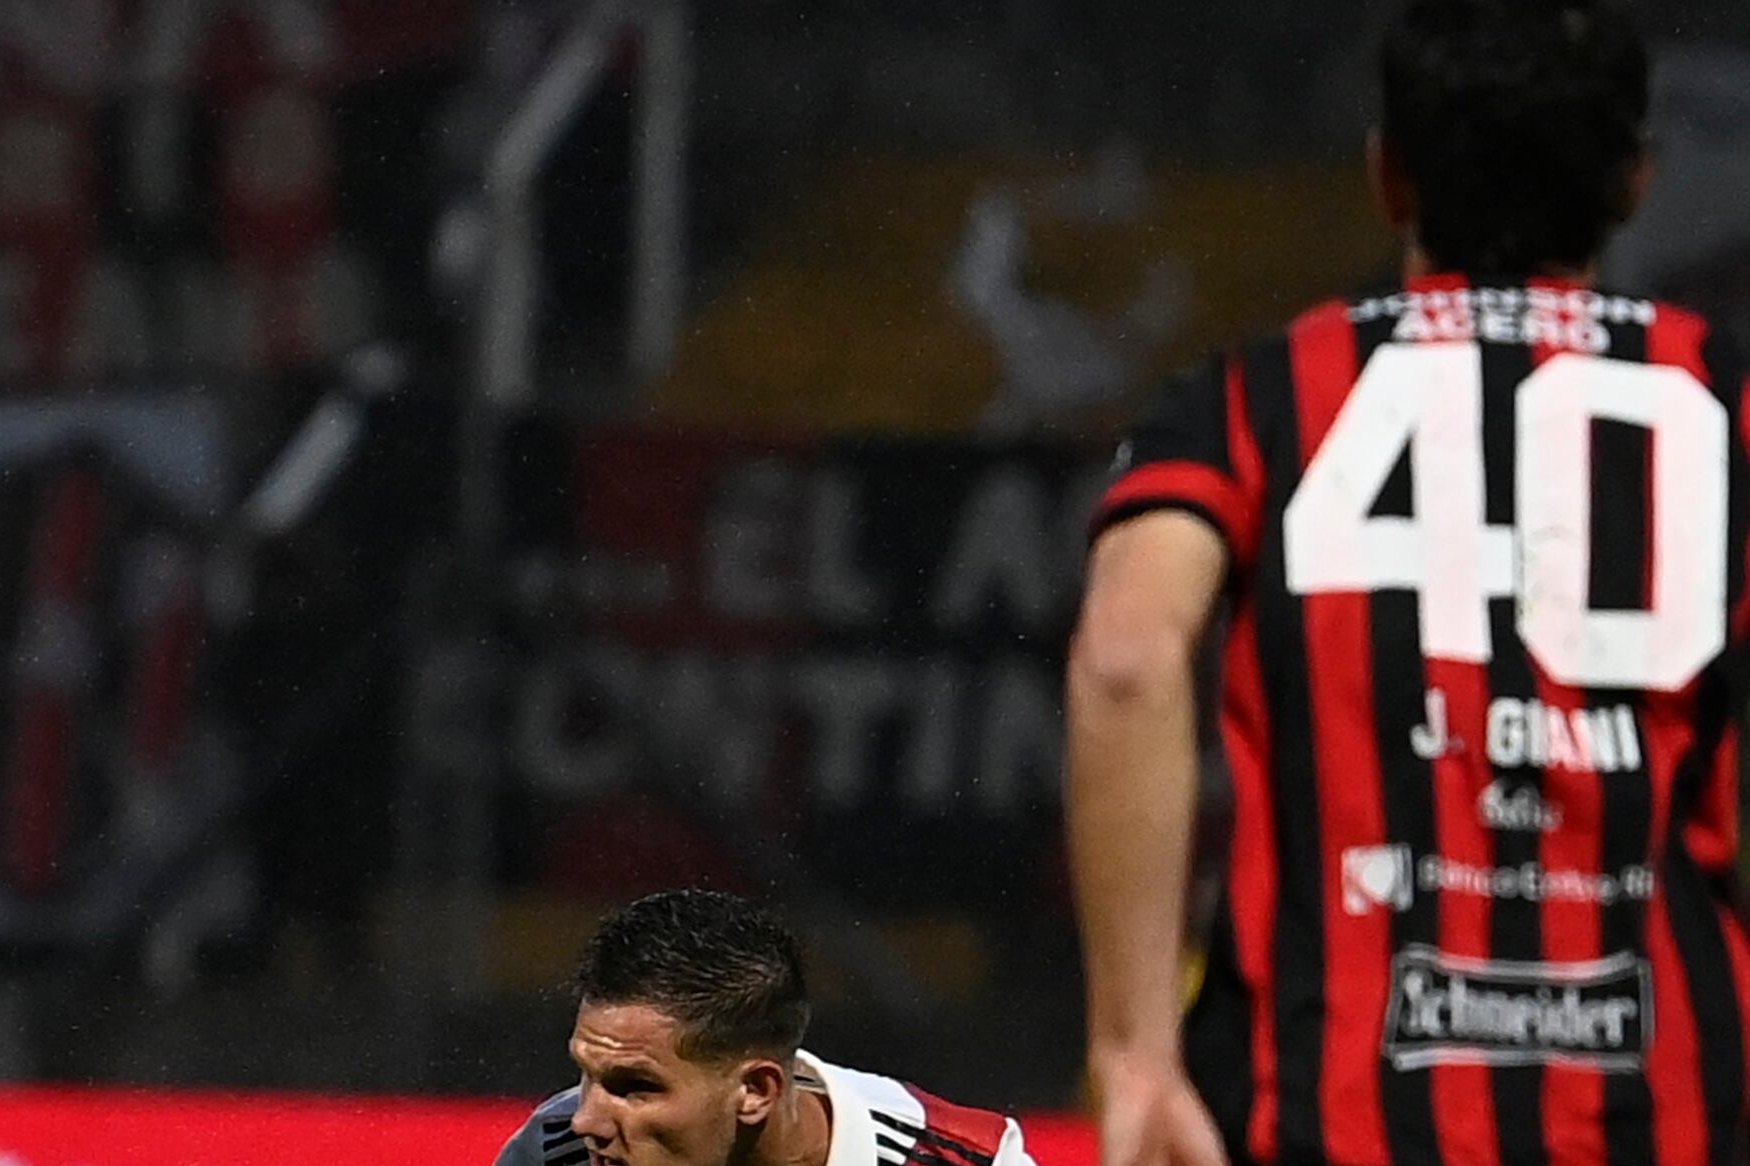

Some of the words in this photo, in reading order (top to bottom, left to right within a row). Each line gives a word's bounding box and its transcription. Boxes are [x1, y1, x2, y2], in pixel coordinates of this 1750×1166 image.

[1284, 343, 1729, 689] 40
[1486, 697, 1642, 772] GIANI
[1402, 970, 1637, 1048] Schneider
